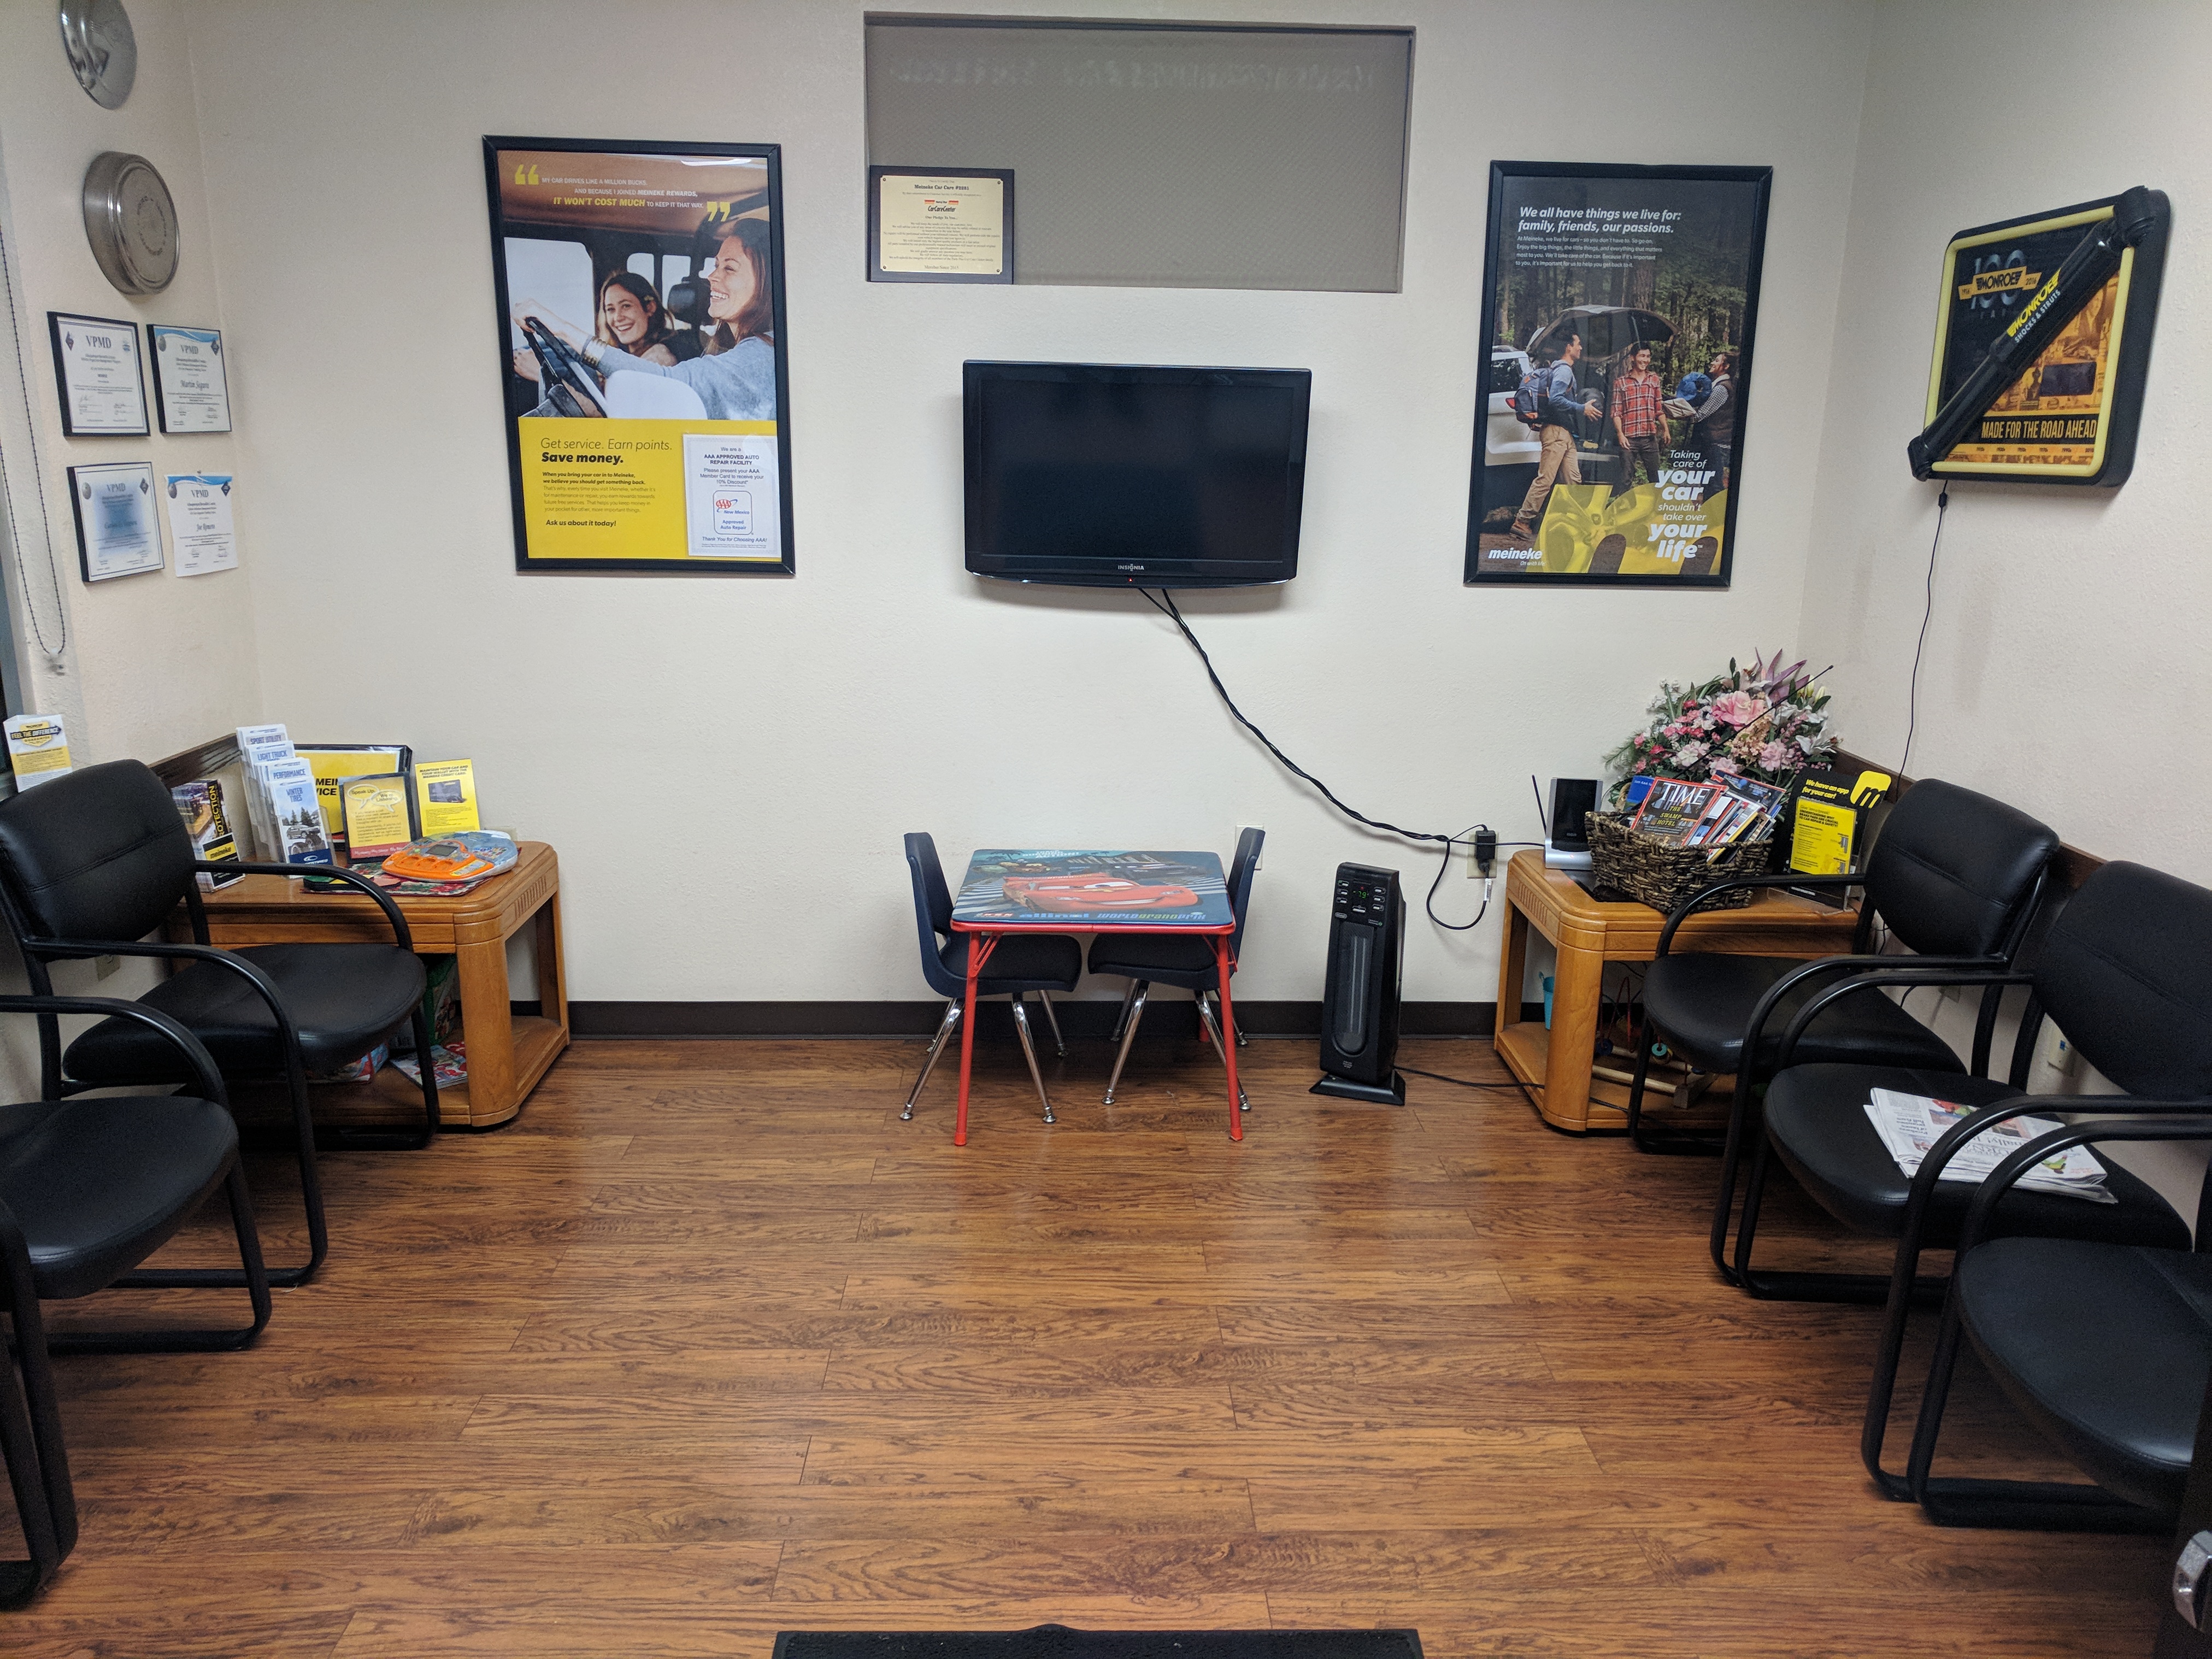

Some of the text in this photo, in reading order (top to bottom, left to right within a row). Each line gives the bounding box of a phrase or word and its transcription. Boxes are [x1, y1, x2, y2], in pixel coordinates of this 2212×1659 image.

[595, 198, 617, 206] COST
[1520, 207, 1538, 217] We
[1539, 207, 1555, 217] all
[1555, 207, 1584, 218] have
[1586, 208, 1620, 221] things
[1640, 209, 1660, 220] live
[1661, 209, 1682, 222] for:
[1518, 220, 1674, 234] family, friends, our passions.
[1976, 270, 2023, 291] MONROE
[2007, 268, 2062, 338] MONROE
[2014, 318, 2037, 343] SHOCKS
[2040, 290, 2061, 314] STRUTS
[86, 335, 111, 349] VPMD
[180, 344, 199, 354] VPMD
[1981, 420, 2097, 438] MADE FOR THE ROAD AHEAD
[541, 437, 672, 451] Get service. Earn points.
[542, 451, 624, 466] Save money.
[1670, 450, 1701, 461] Taking
[1696, 459, 1708, 469] of
[1655, 470, 1716, 488] your
[191, 490, 209, 498] VPMD
[1662, 486, 1704, 501] car
[1658, 503, 1702, 511] shouldn't
[1663, 513, 1684, 521] take
[1648, 523, 1708, 542] your
[1489, 548, 1543, 560] meineke
[1118, 563, 1144, 572] INSIGNIA
[272, 750, 287, 760] TRUCK
[273, 768, 306, 779] PERFORMANCE
[286, 787, 303, 796] WINTER
[1815, 781, 1829, 790] have
[290, 795, 303, 803] TIRES
[1661, 783, 1710, 805] TIME
[209, 785, 225, 836] ROTECTION
[210, 847, 232, 859] meineke
